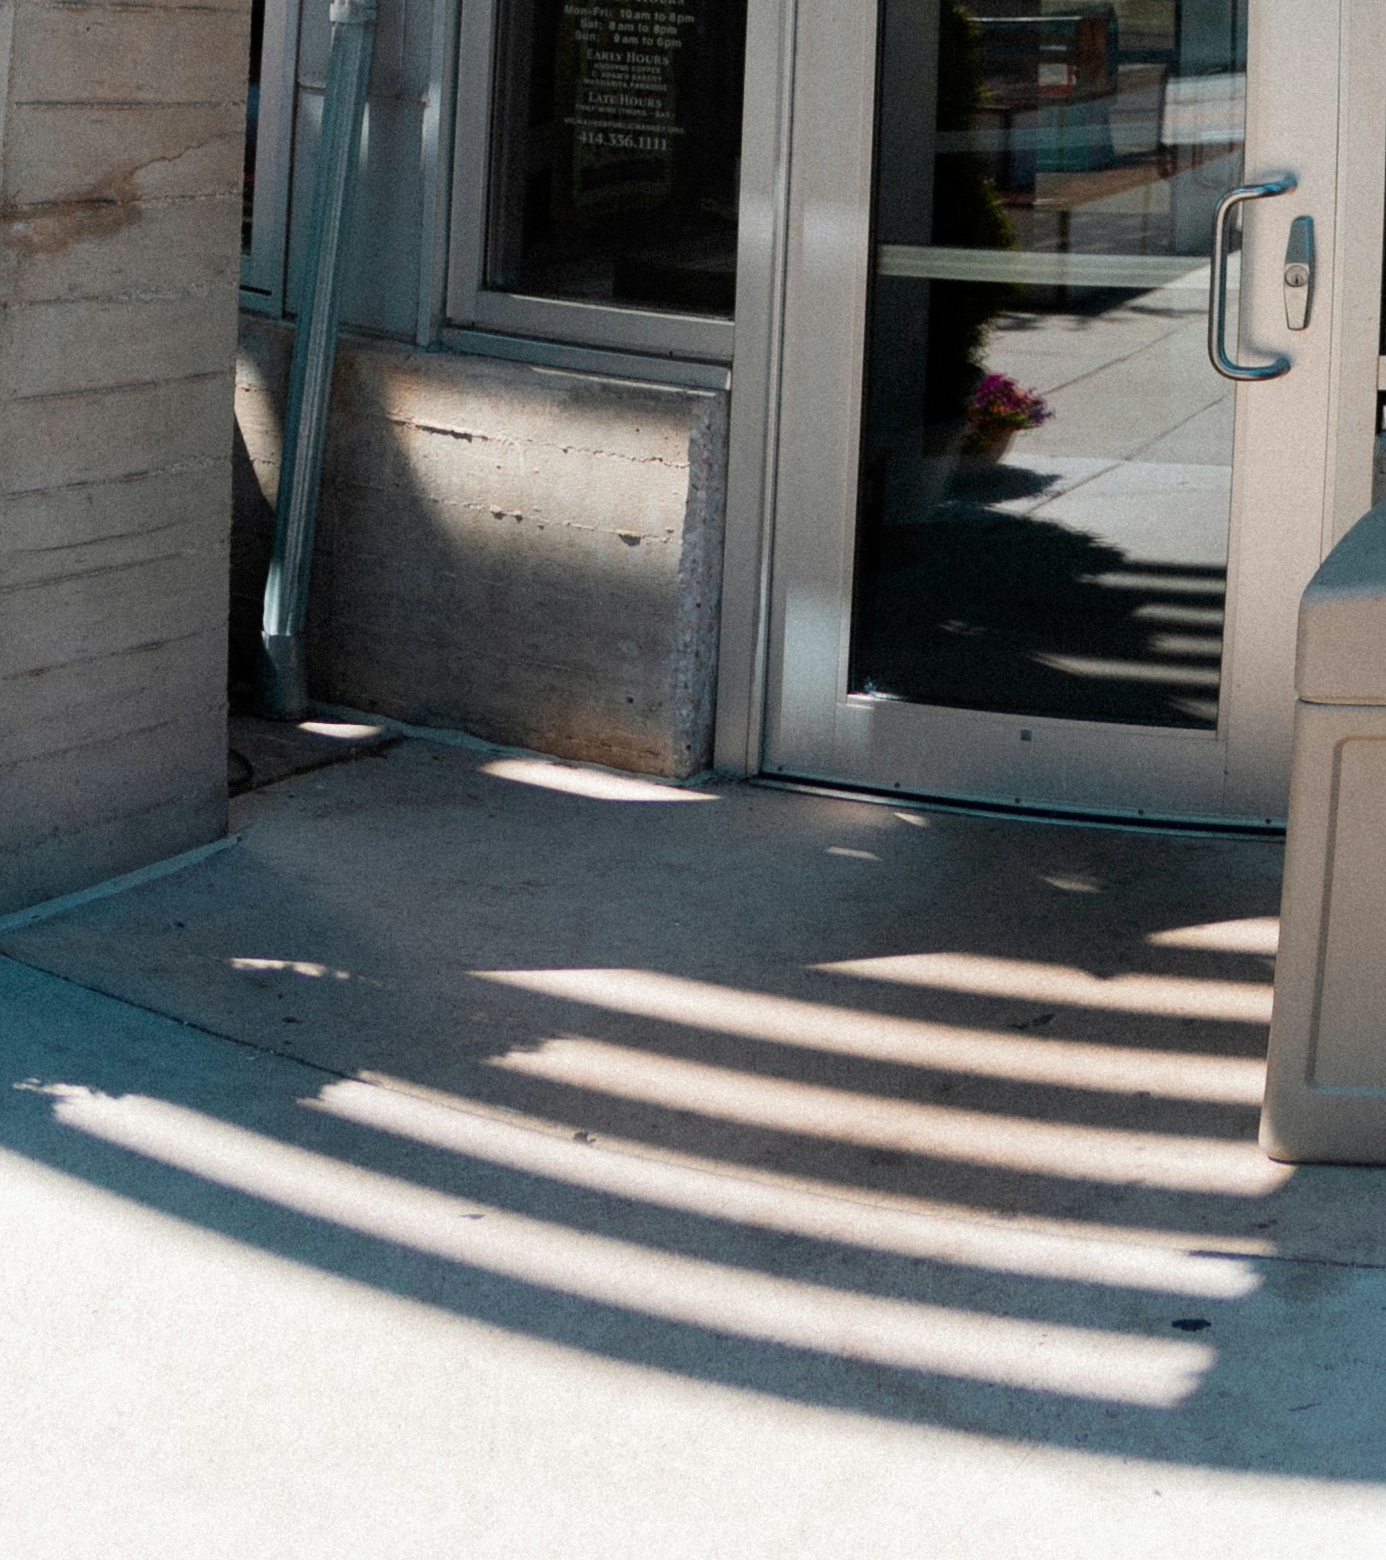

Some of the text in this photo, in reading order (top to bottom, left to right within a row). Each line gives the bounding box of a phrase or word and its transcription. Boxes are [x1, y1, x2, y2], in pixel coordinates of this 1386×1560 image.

[654, 12, 666, 22] to
[638, 23, 649, 33] to
[642, 36, 654, 46] to
[586, 48, 669, 66] EARLY HOURS
[588, 91, 662, 108] LATE HOURS
